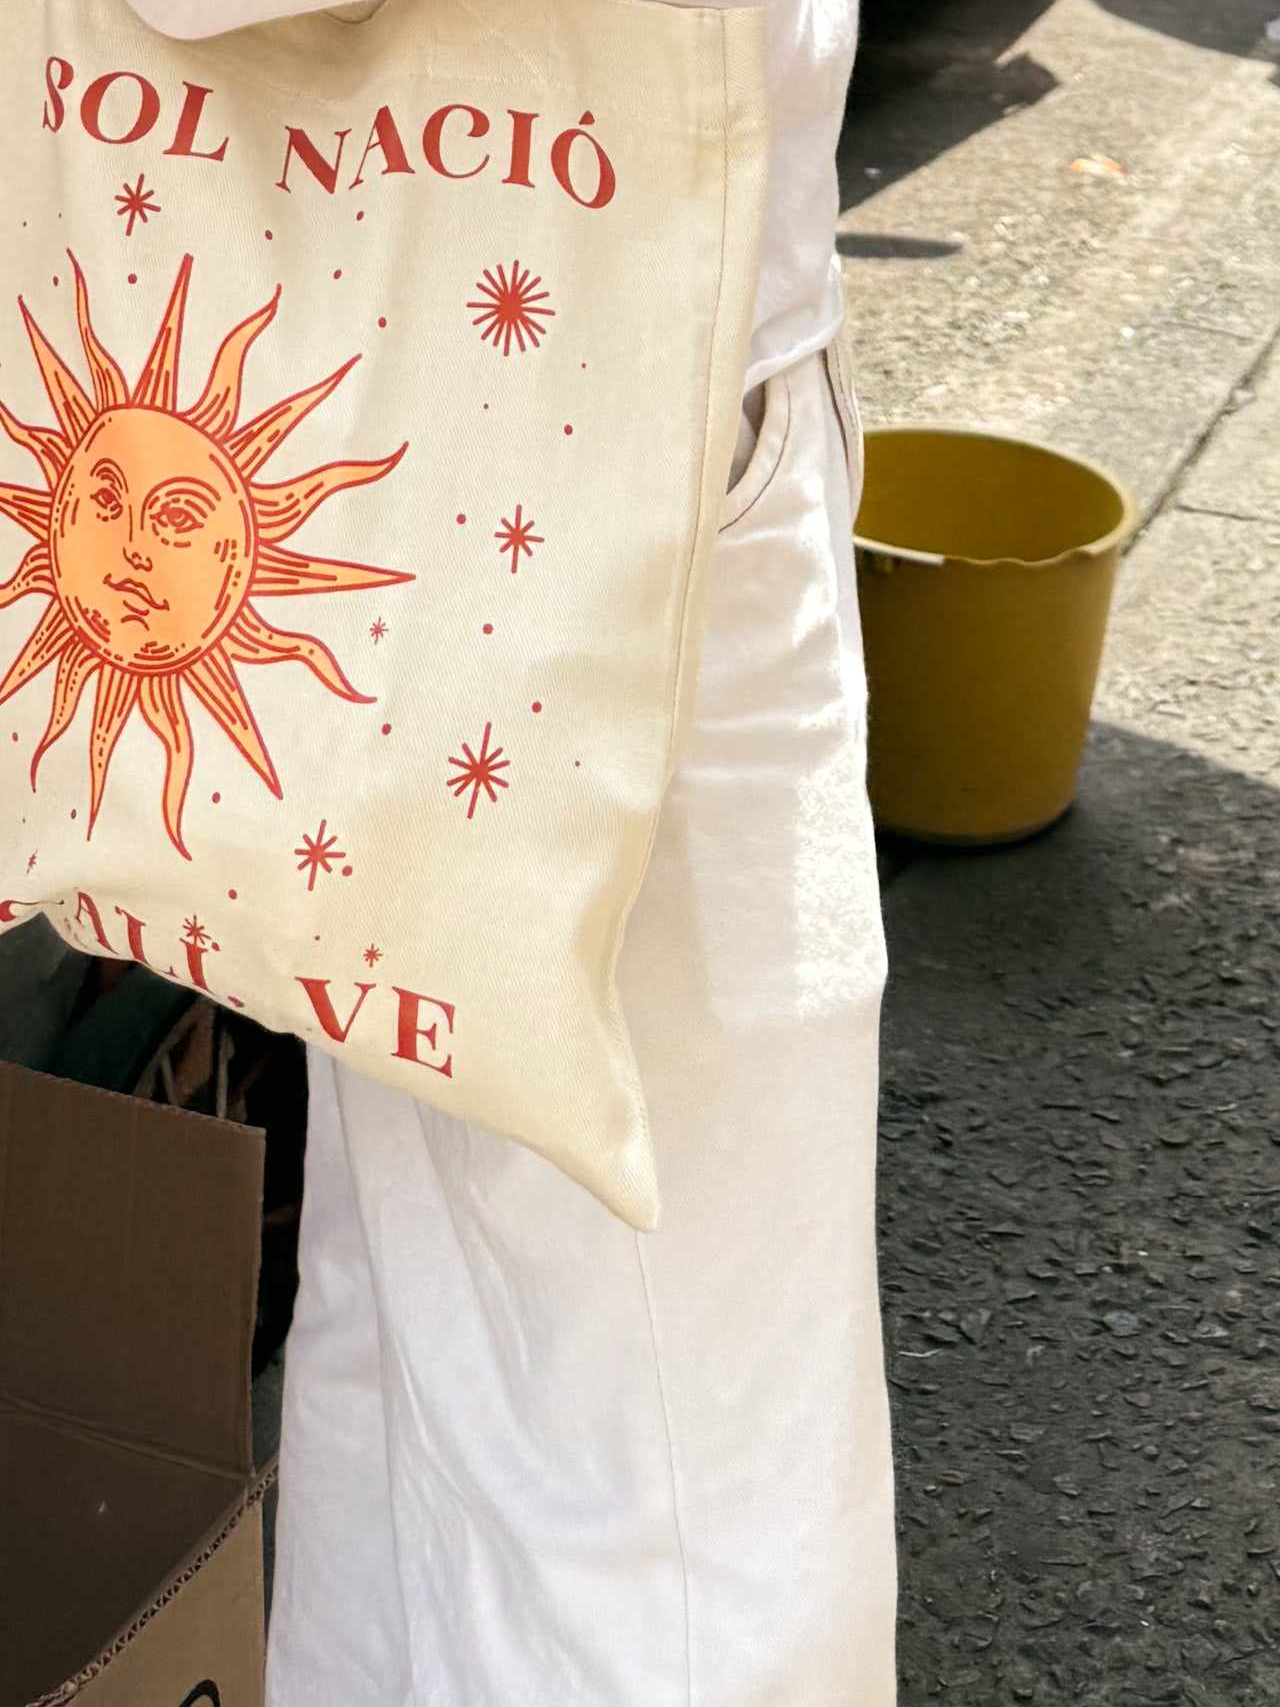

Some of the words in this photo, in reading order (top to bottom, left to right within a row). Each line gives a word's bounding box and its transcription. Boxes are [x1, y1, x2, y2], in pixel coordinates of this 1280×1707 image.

[42, 56, 229, 163] SOL
[276, 104, 616, 210] NACIÓ
[295, 976, 456, 1079] VE
